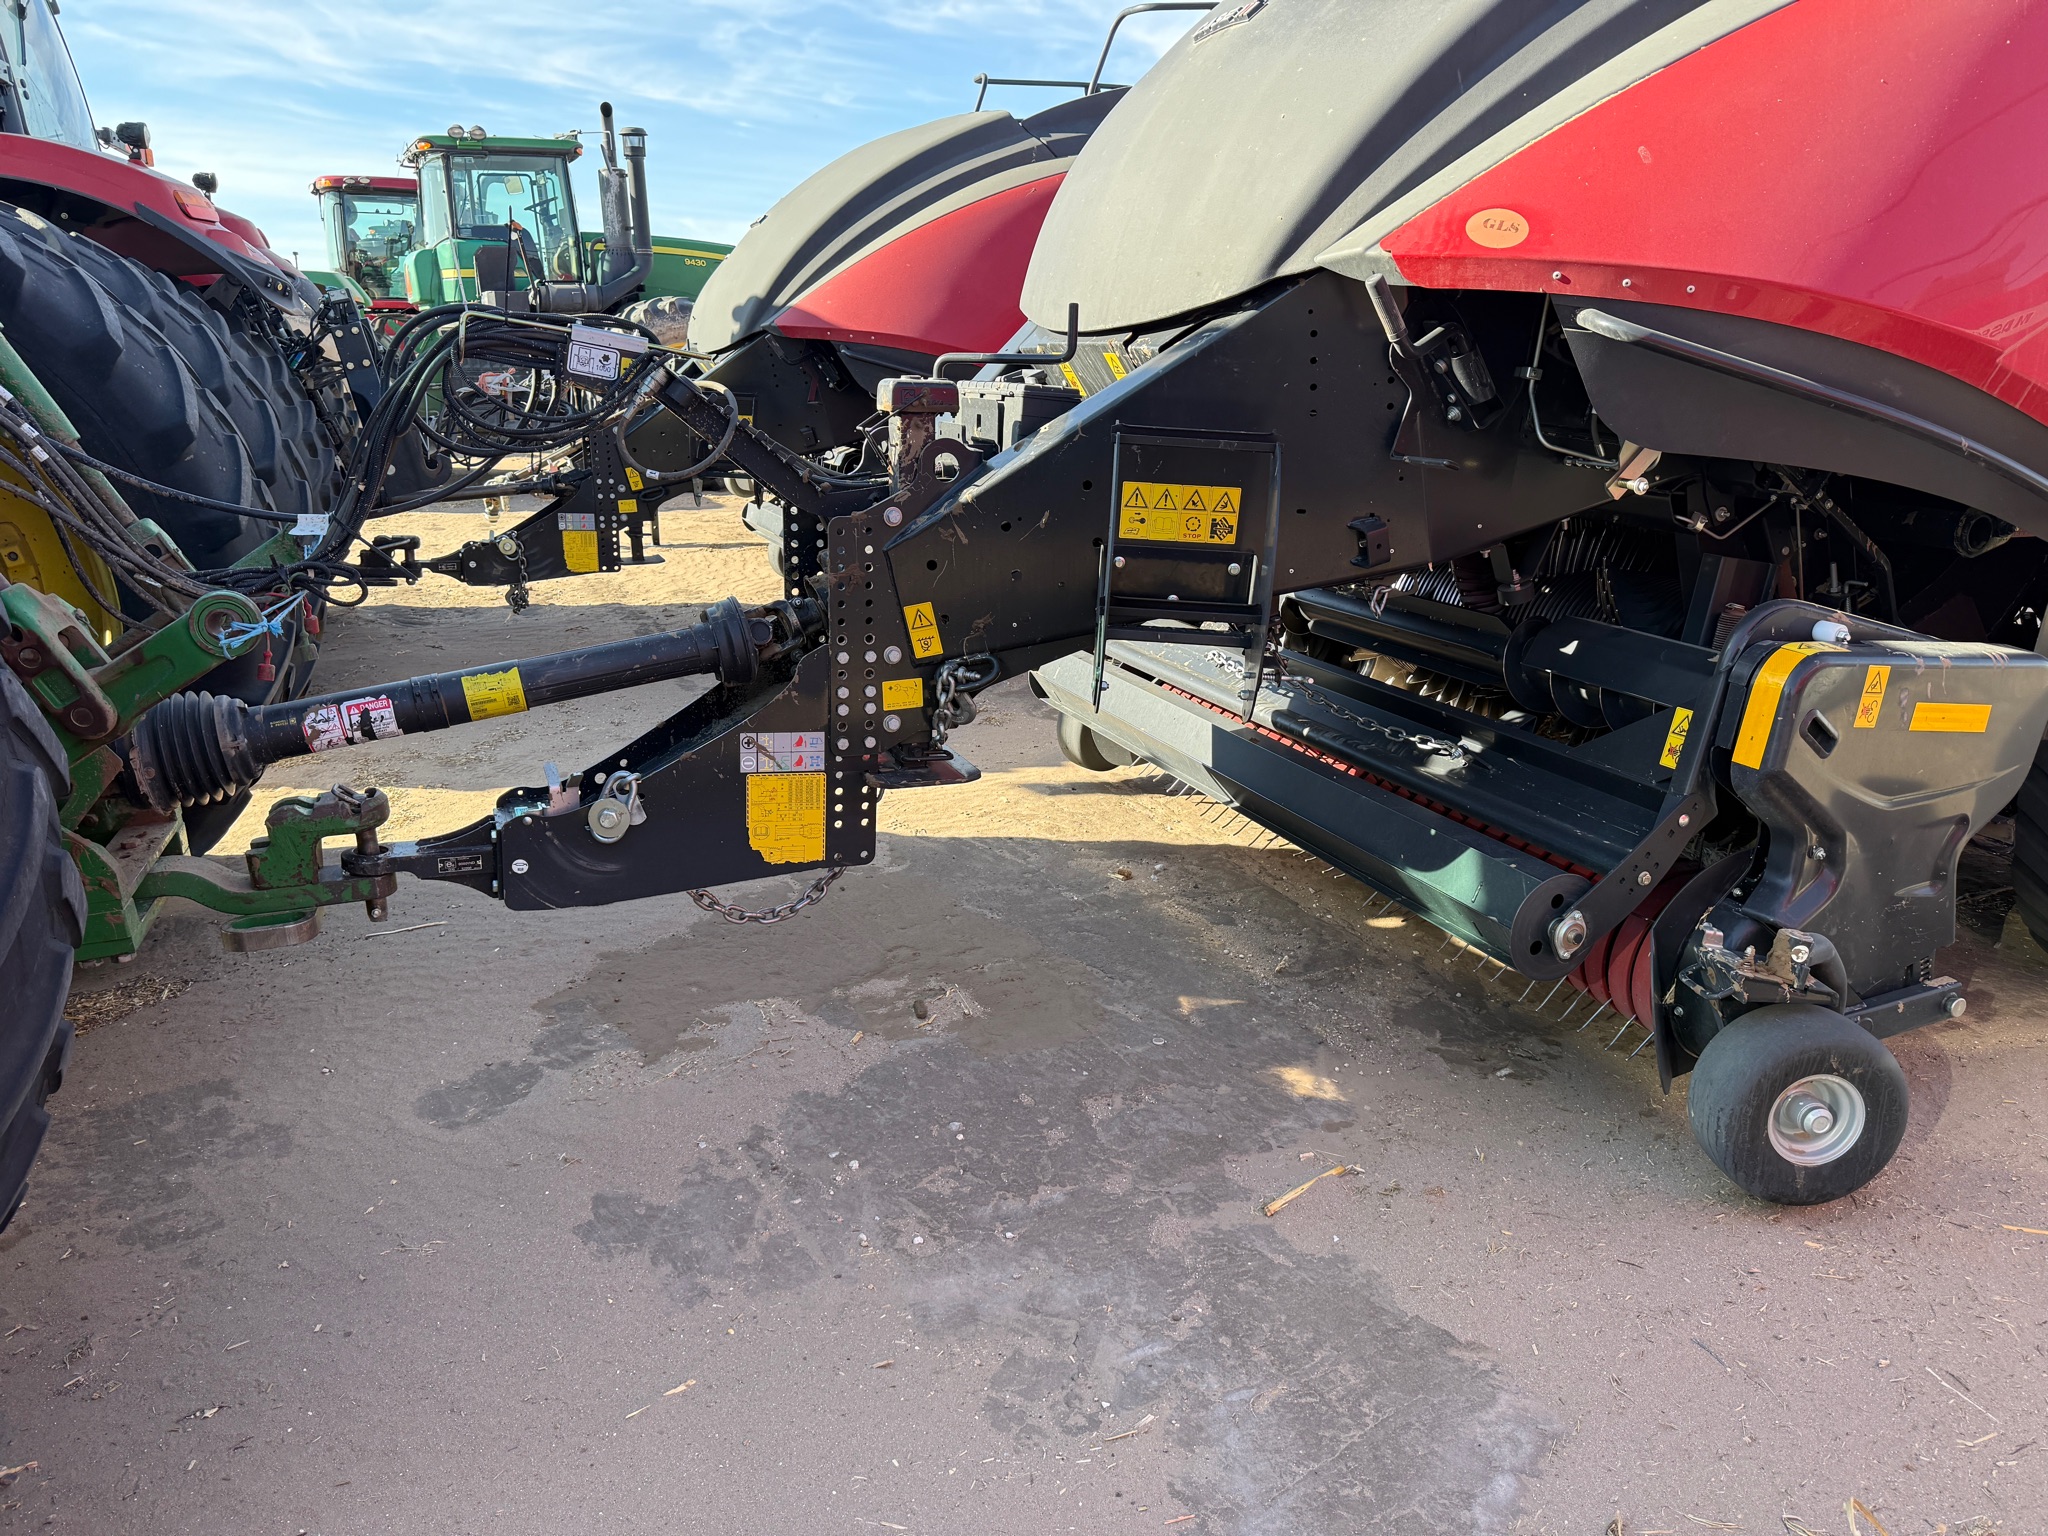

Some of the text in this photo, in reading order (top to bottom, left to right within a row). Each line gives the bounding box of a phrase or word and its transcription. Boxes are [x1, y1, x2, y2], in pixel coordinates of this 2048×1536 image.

[1482, 218, 1520, 233] GLS
[684, 258, 707, 267] 9430
[359, 699, 389, 712] DANGER
